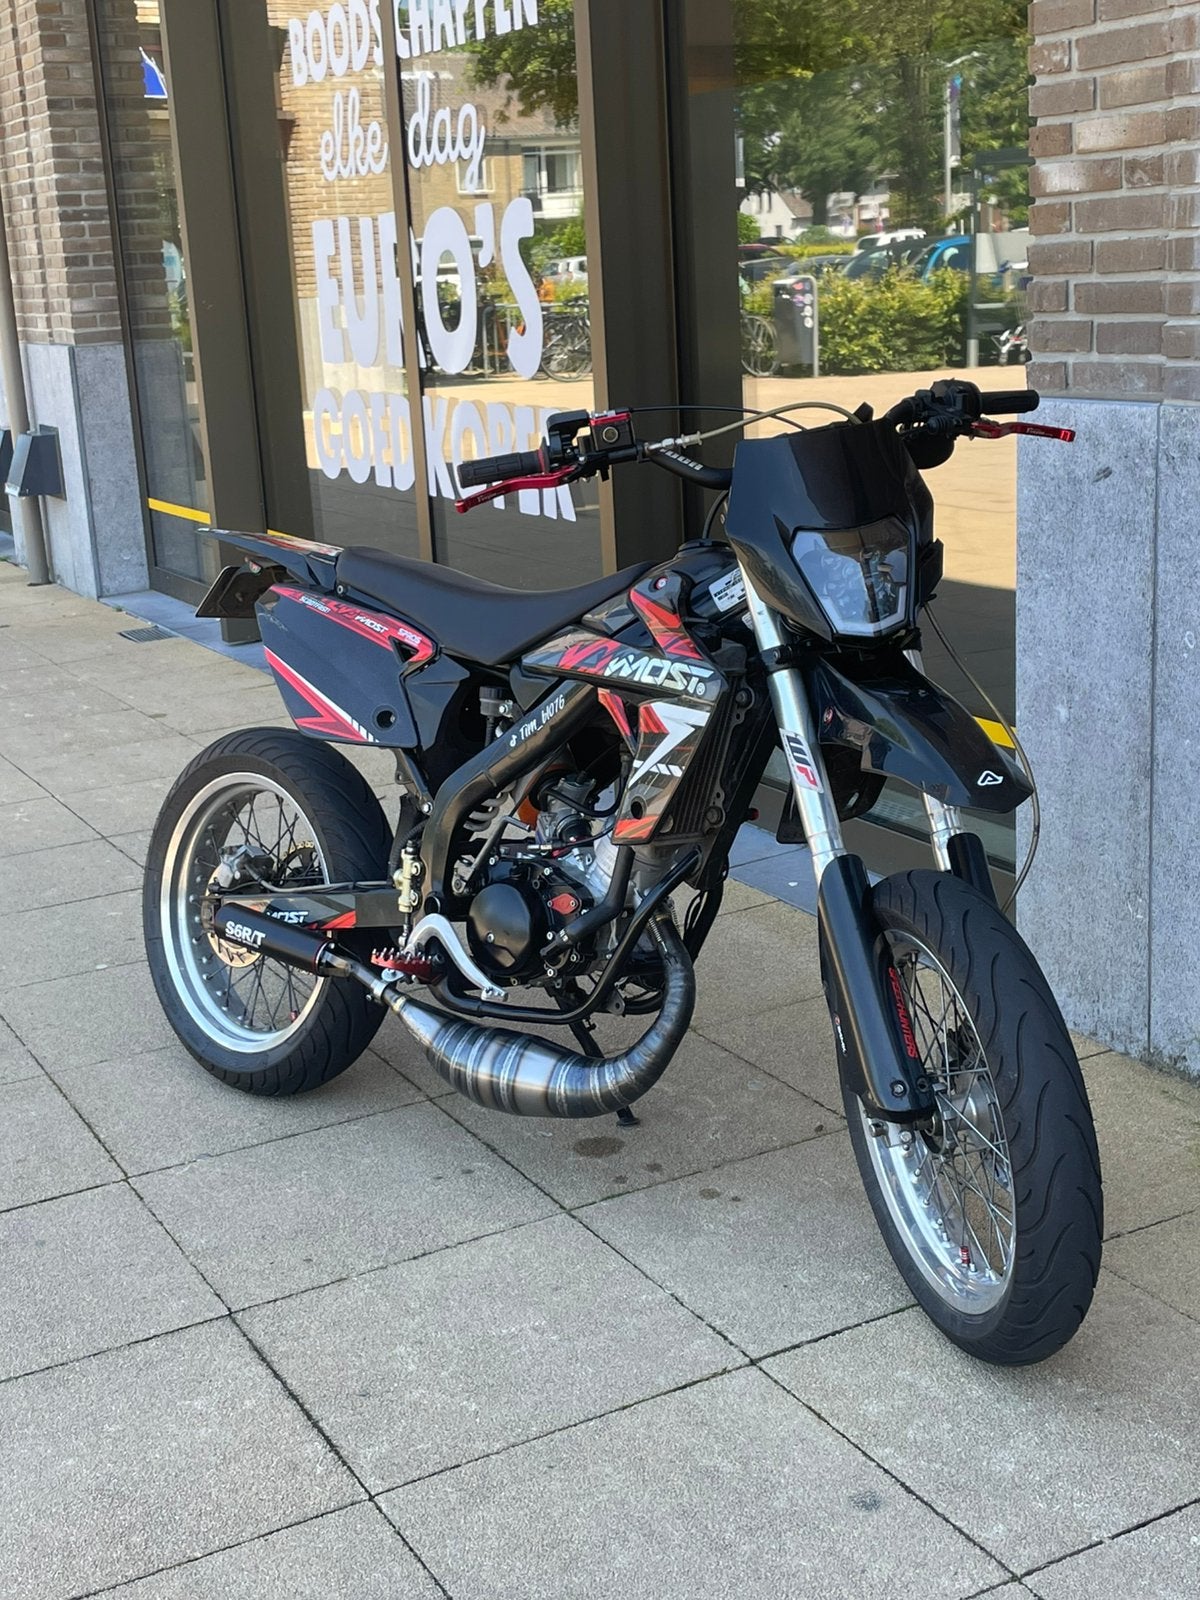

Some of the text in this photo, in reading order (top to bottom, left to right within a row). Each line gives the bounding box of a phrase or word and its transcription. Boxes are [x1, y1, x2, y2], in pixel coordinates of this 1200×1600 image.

[320, 71, 486, 194] elke dag
[312, 197, 543, 379] EURO'S
